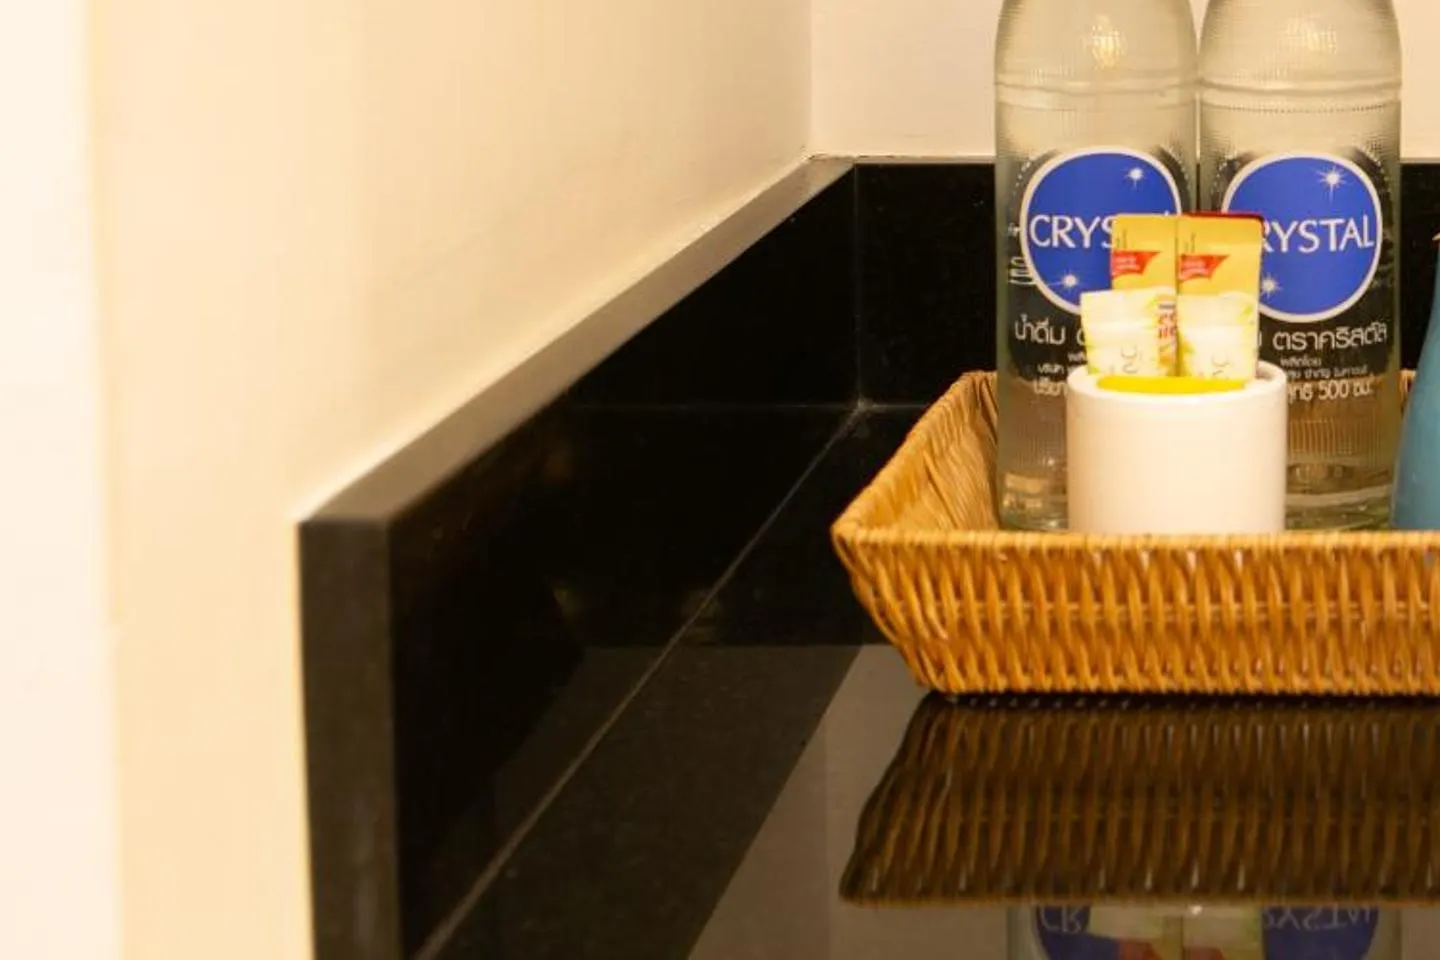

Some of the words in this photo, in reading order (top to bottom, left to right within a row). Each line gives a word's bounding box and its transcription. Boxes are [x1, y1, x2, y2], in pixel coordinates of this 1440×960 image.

[1030, 214, 1113, 248] CRYS
[1262, 214, 1375, 253] RYSTAL
[1318, 379, 1349, 400] 500
